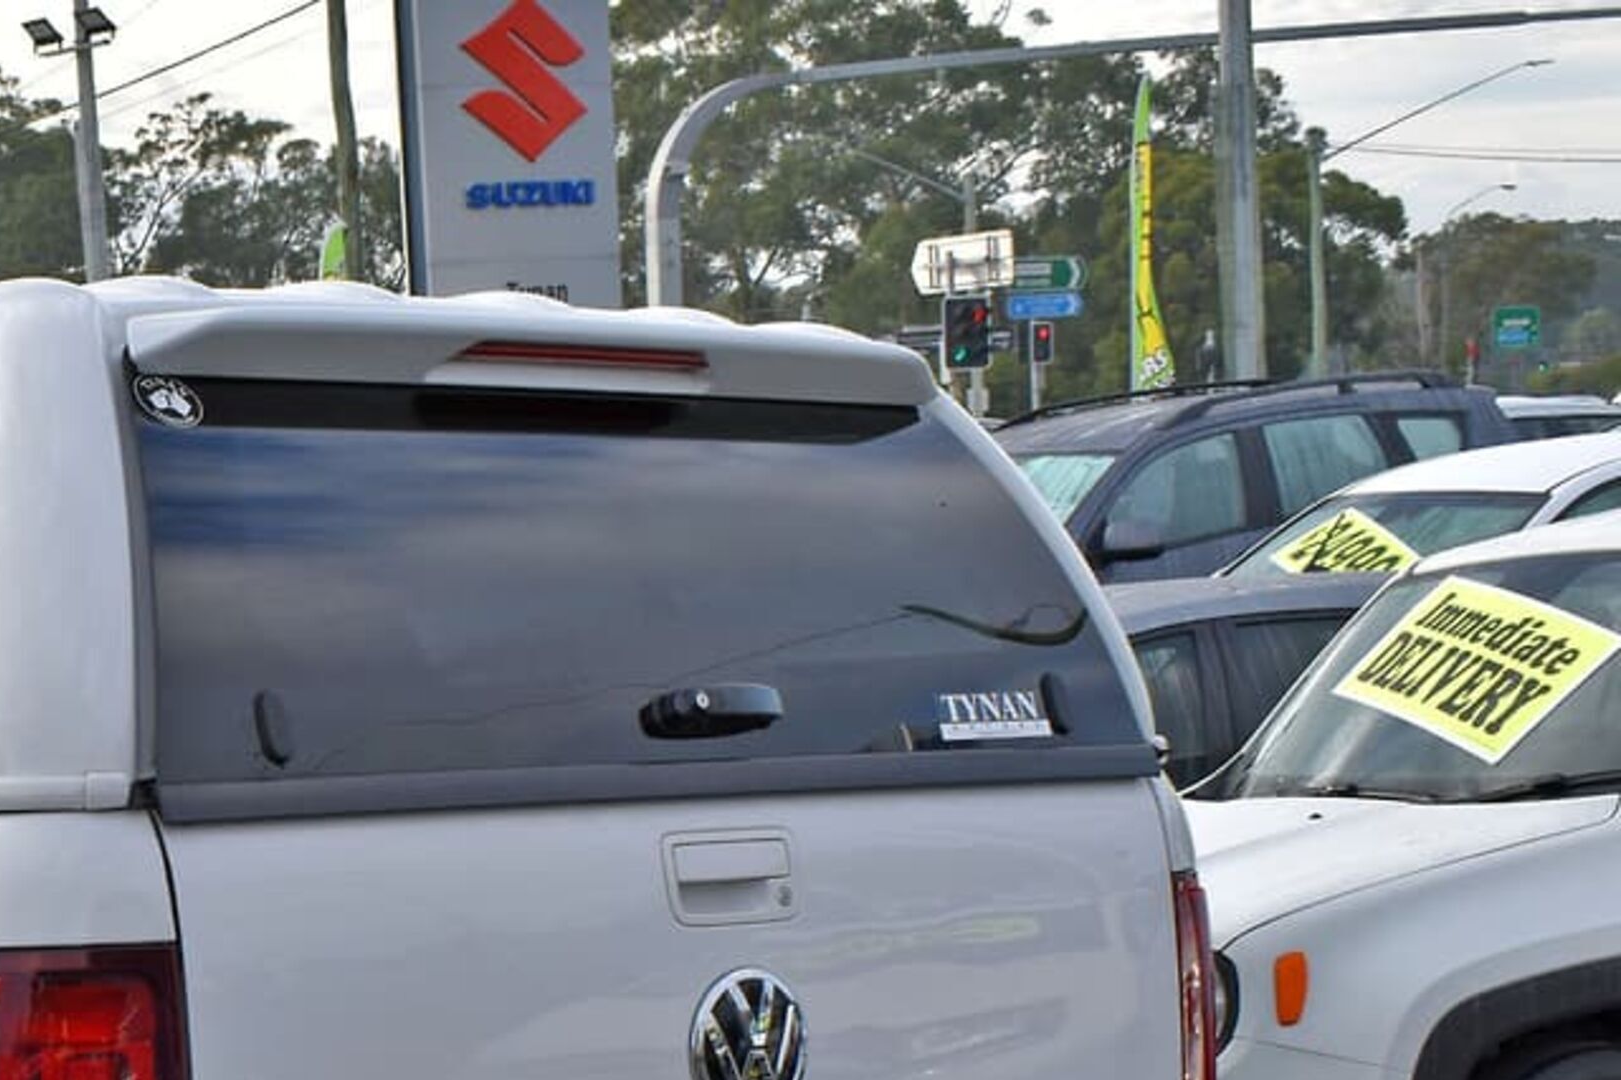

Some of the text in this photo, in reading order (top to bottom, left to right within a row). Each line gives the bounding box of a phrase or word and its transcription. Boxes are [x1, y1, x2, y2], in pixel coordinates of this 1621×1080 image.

[465, 180, 595, 210] SUZUKI
[1414, 592, 1582, 676] Immediate
[939, 690, 1039, 721] TYNAN
[1357, 630, 1552, 736] DELIVERY
